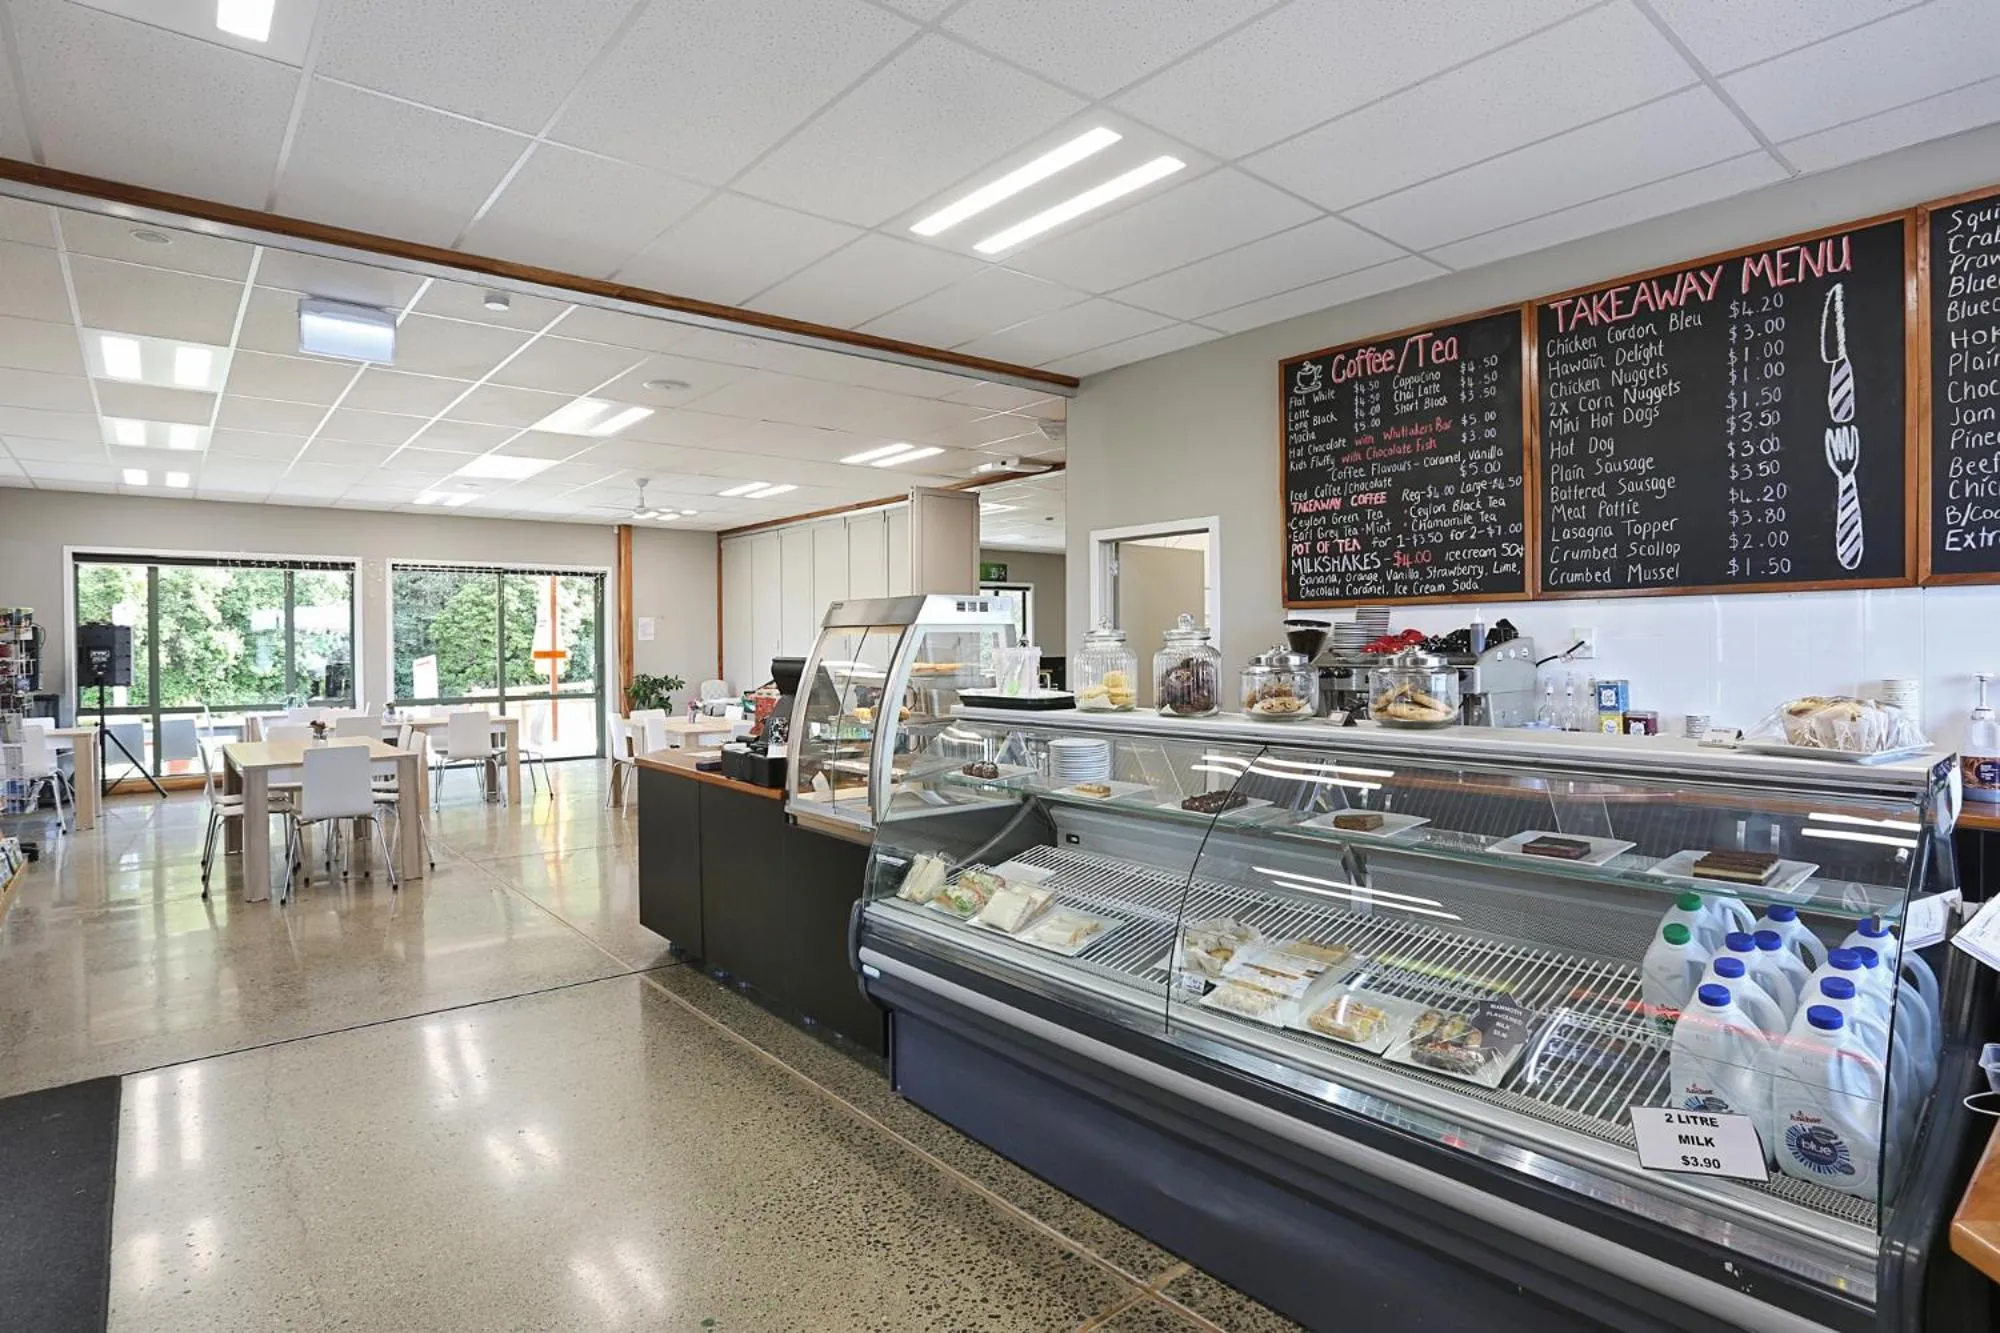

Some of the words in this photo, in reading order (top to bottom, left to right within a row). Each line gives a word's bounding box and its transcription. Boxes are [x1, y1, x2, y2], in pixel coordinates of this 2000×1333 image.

[1549, 264, 1724, 333] TAKEAWAY
[1741, 235, 1852, 295] MENU
[1948, 272, 2000, 297] Blue
[1546, 334, 1597, 358] Chicken
[1607, 322, 1657, 344] Cordon
[1668, 310, 1702, 332] Bleu
[1728, 291, 1784, 319] $4.20
[1615, 339, 1665, 366] Delight
[1728, 316, 1785, 344] $3.00
[1331, 332, 1458, 384] Coffee/Tea
[1460, 355, 1498, 375] $4.50
[1550, 377, 1601, 400] Chicken
[1611, 361, 1669, 388] Nuggets
[1727, 339, 1784, 368] $1.00
[1289, 394, 1306, 410] Flat
[1313, 388, 1336, 403] White
[1353, 380, 1380, 394] $4.50
[1394, 388, 1414, 403] Chai
[1418, 383, 1440, 397] Latte
[1460, 370, 1498, 388] $4.50
[1394, 399, 1418, 415] Short
[1424, 395, 1448, 410] Black
[1460, 386, 1497, 403] $3.50
[1578, 395, 1615, 412] Corn
[1623, 378, 1681, 406] Nuggets
[1728, 361, 1785, 386] $1.00
[1289, 409, 1310, 422] Latte
[1289, 420, 1309, 433] Long
[1313, 411, 1338, 427] Black
[1549, 416, 1580, 438] Mini
[1591, 412, 1614, 429] Hot
[1623, 404, 1660, 428] Dogs
[1725, 386, 1782, 412] $1.50
[1950, 406, 1995, 426] Jam
[1289, 431, 1316, 445] Mocha
[1354, 418, 1381, 433] $5.00
[1308, 437, 1347, 455] Chocolate
[1435, 416, 1453, 432] Bar
[1461, 410, 1497, 426] $5.00
[1550, 437, 1574, 459] Hot
[1588, 436, 1614, 458] Dog
[1726, 409, 1781, 436] $3.50
[1950, 428, 2000, 450] Pine
[1290, 460, 1307, 472] Kids
[1310, 454, 1335, 472] Fluffy
[1366, 443, 1412, 460] Chocolate
[1461, 427, 1497, 444] $3.00
[1331, 466, 1366, 481] Coffee
[1371, 460, 1412, 476] Flavours
[1468, 445, 1504, 460] Vanilla
[1290, 490, 1308, 502] Iced
[1460, 459, 1501, 478] $5.00
[1550, 481, 1606, 503] Battered
[1617, 475, 1676, 499] Sausage
[1729, 459, 1780, 481] $3.50
[1551, 463, 1585, 485] Plain
[1594, 455, 1656, 476] Sausage
[1949, 476, 2000, 500] Chic
[1291, 497, 1342, 514] TAKEAWAY
[1350, 491, 1388, 507] COFFEE
[1410, 503, 1446, 521] Ceylon
[1452, 498, 1482, 513] Black
[1487, 495, 1506, 508] Tea
[1551, 504, 1586, 523] Meat
[1598, 499, 1640, 518] Pattie
[1729, 482, 1787, 504] $4.20
[1290, 515, 1326, 532] Ceylon
[1332, 512, 1359, 525] Green
[1366, 508, 1383, 520] Tea
[1292, 529, 1313, 542] Earl
[1317, 526, 1339, 541] Grey
[1344, 525, 1359, 537] Tea
[1366, 519, 1392, 535] Mint
[1412, 512, 1474, 532] Chamomile
[1479, 510, 1497, 523] Tea
[1551, 525, 1613, 543] Lasagna
[1621, 518, 1679, 540] Topper
[1728, 506, 1785, 527] $3.80
[1291, 541, 1311, 557] POT
[1316, 540, 1330, 554] OF
[1337, 538, 1361, 553] TEA
[1372, 536, 1392, 548] for
[1450, 529, 1468, 541] for
[1550, 543, 1617, 564] Crumbed
[1728, 531, 1789, 550] $2.00
[1945, 526, 2000, 552] Extr
[1291, 551, 1382, 575] MILKSHAKES
[1392, 550, 1432, 568] $4.00
[1549, 567, 1612, 585] Crumbed
[1627, 562, 1680, 584] Mussel
[1726, 556, 1792, 576] $1.50
[1393, 582, 1408, 595] Ice
[1412, 581, 1445, 595] Cream
[1664, 1112, 1675, 1123] 2
[1677, 1114, 1719, 1127] LITRE
[1678, 1134, 1716, 1147] MILK
[1801, 1138, 1833, 1156] blue
[1681, 1155, 1721, 1169] $3.90
